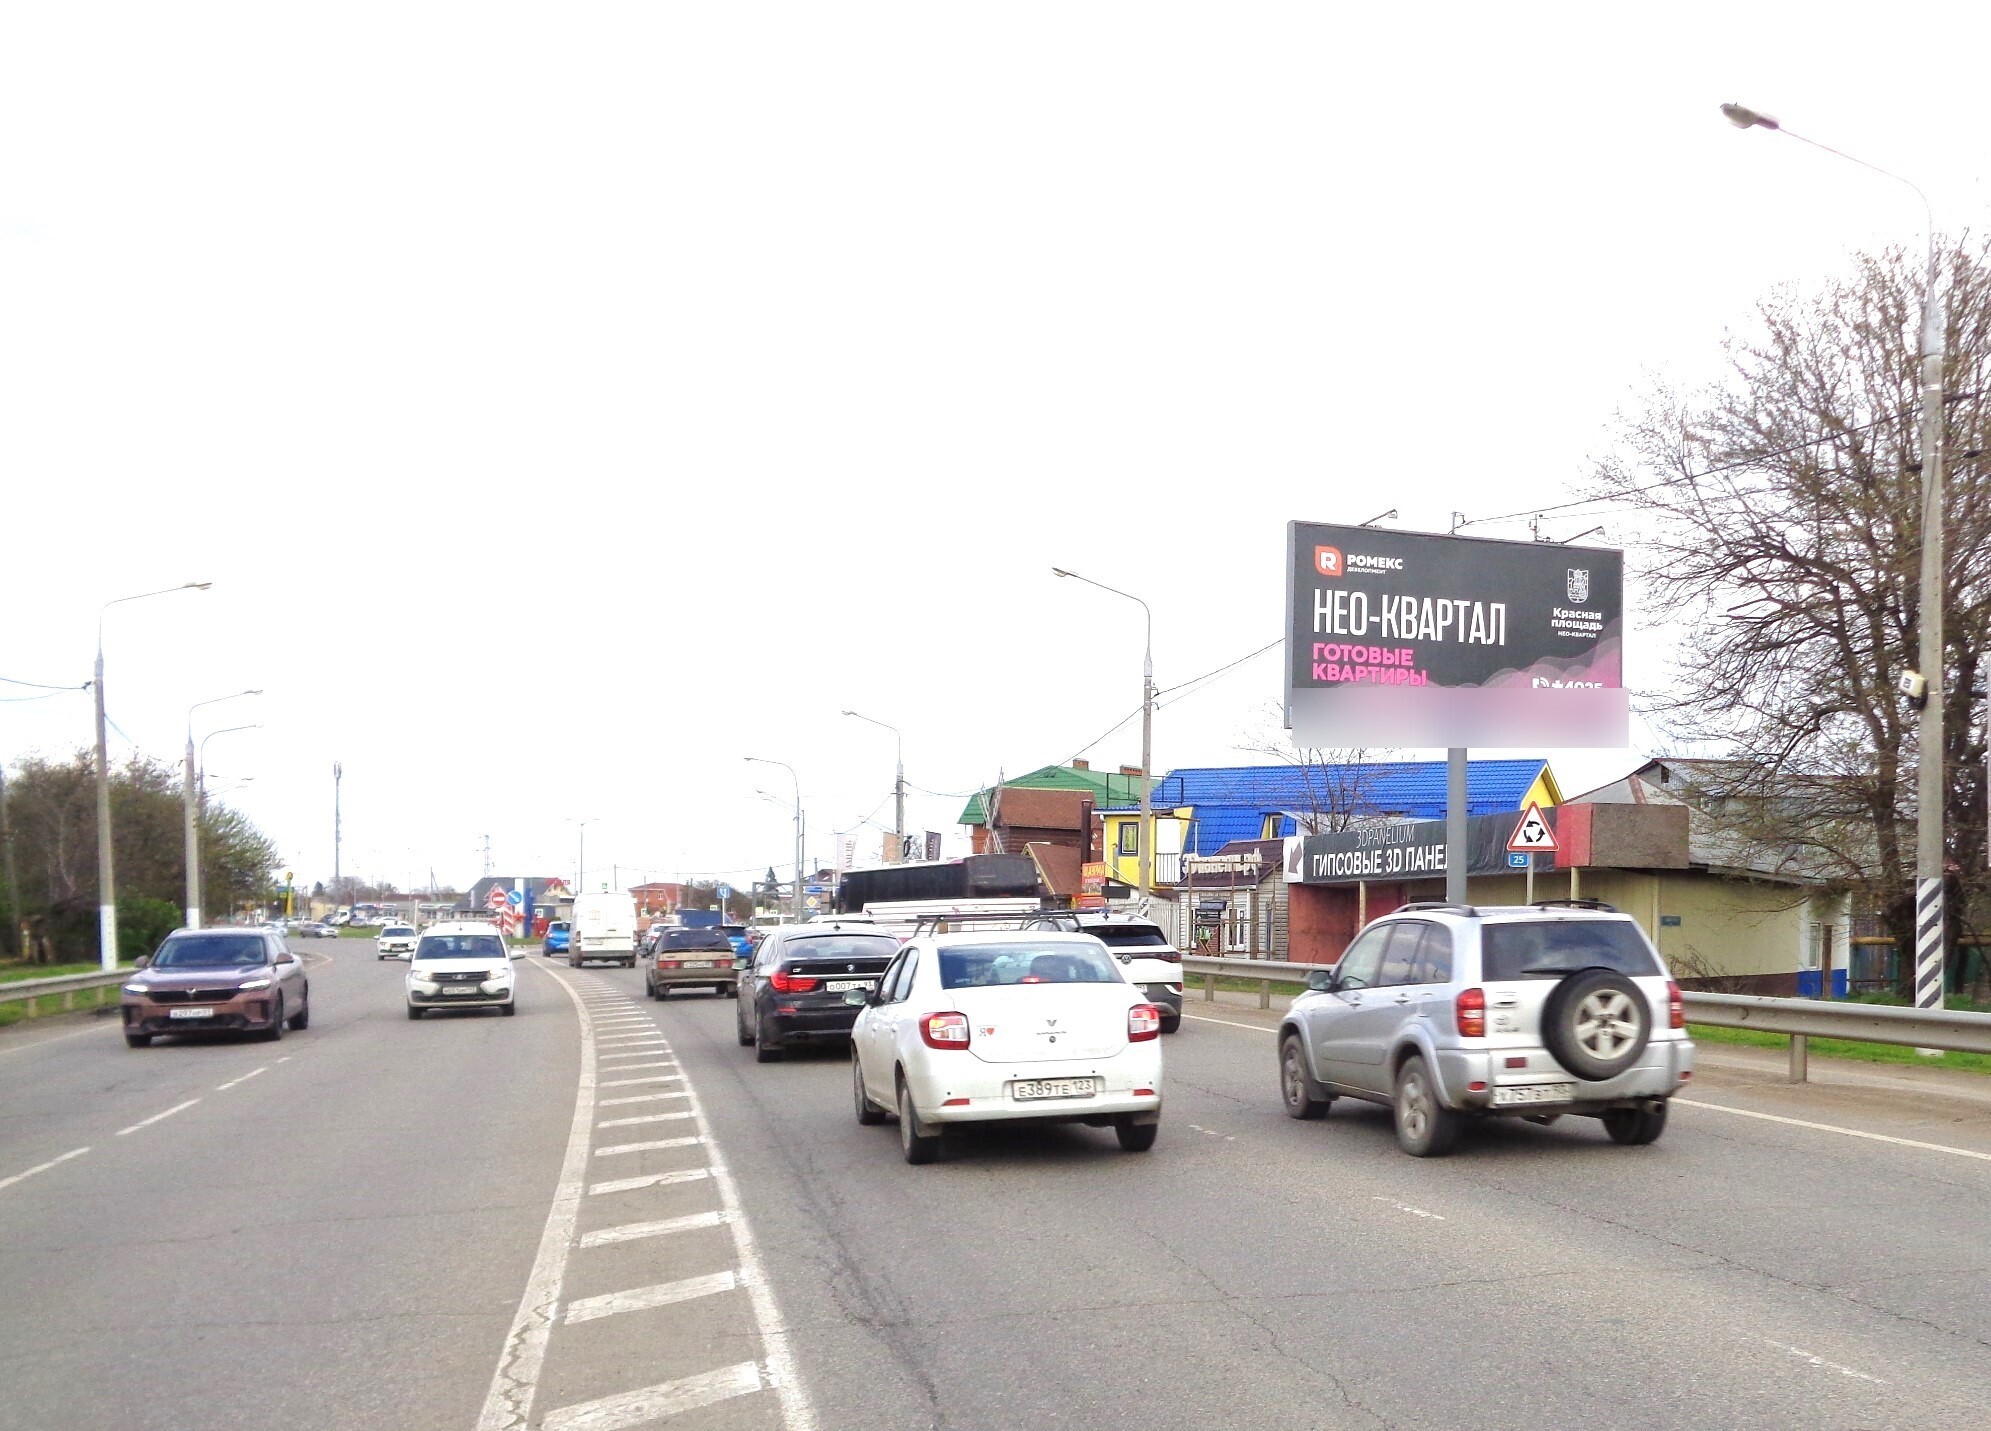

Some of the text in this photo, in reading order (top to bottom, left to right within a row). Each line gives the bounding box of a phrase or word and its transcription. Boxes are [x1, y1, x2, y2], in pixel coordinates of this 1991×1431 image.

[1346, 554, 1404, 570] РОМЕКС
[1313, 588, 1506, 646] НЕО-КВАРТАЛ
[1553, 607, 1602, 620] Красная
[1551, 619, 1603, 632] площадь
[1557, 630, 1597, 639] НЕО-КВАРТАЛ
[1312, 642, 1414, 667] ГОТОВЫЕ
[1312, 662, 1428, 687] КВАРТИРЫ
[1355, 824, 1415, 849] 3DPANELIUM
[1313, 844, 1448, 877] ГИПСОВЫЕ 3D ПАНЕ
[1513, 855, 1525, 864] 25
[1018, 1080, 1092, 1097] Е389ТЕ 123
